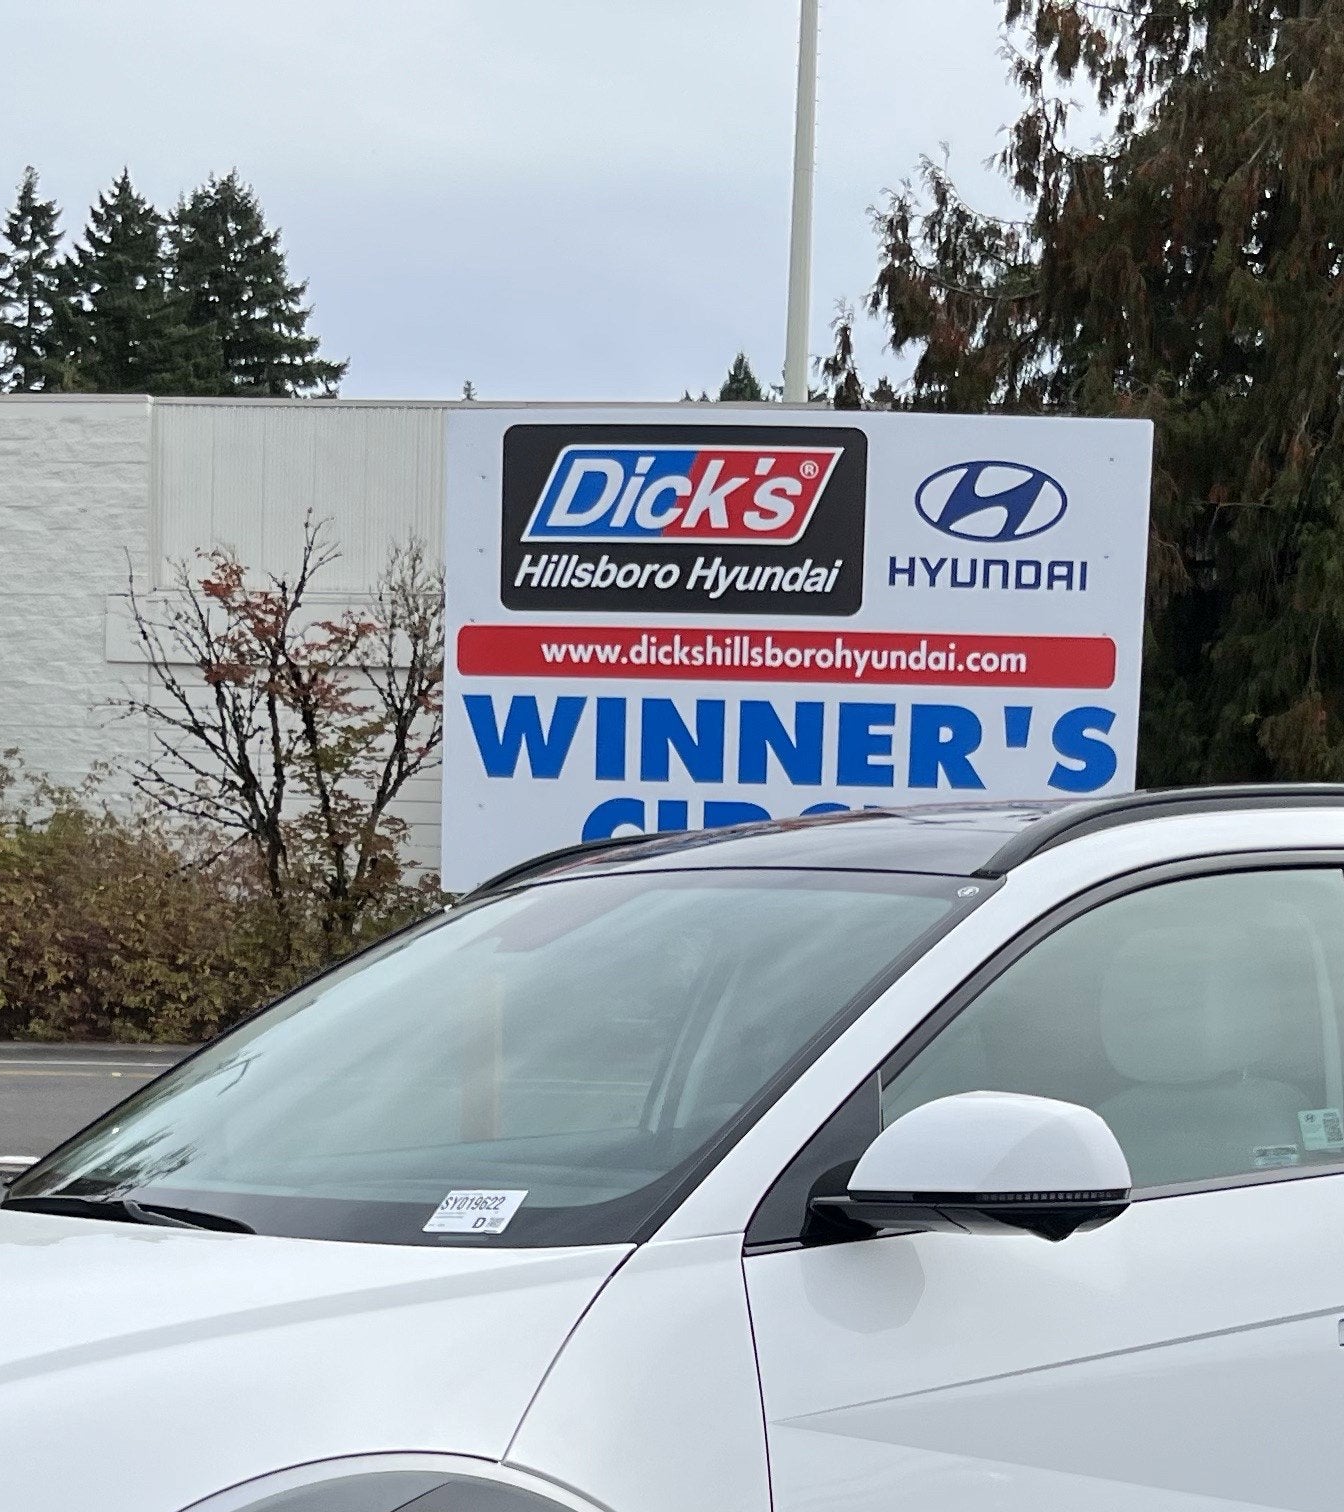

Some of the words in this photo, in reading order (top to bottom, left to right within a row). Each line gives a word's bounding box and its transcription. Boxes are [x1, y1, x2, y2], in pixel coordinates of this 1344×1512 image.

[544, 453, 802, 534] Dick's
[513, 552, 678, 591] Hillsboro
[685, 555, 844, 600] Hyundai
[888, 555, 1088, 592] HYUNDAI
[540, 634, 1028, 676] www.dickshillsborohyundai.com
[462, 694, 1119, 791] WINNER'S
[440, 1196, 506, 1211] SY019622
